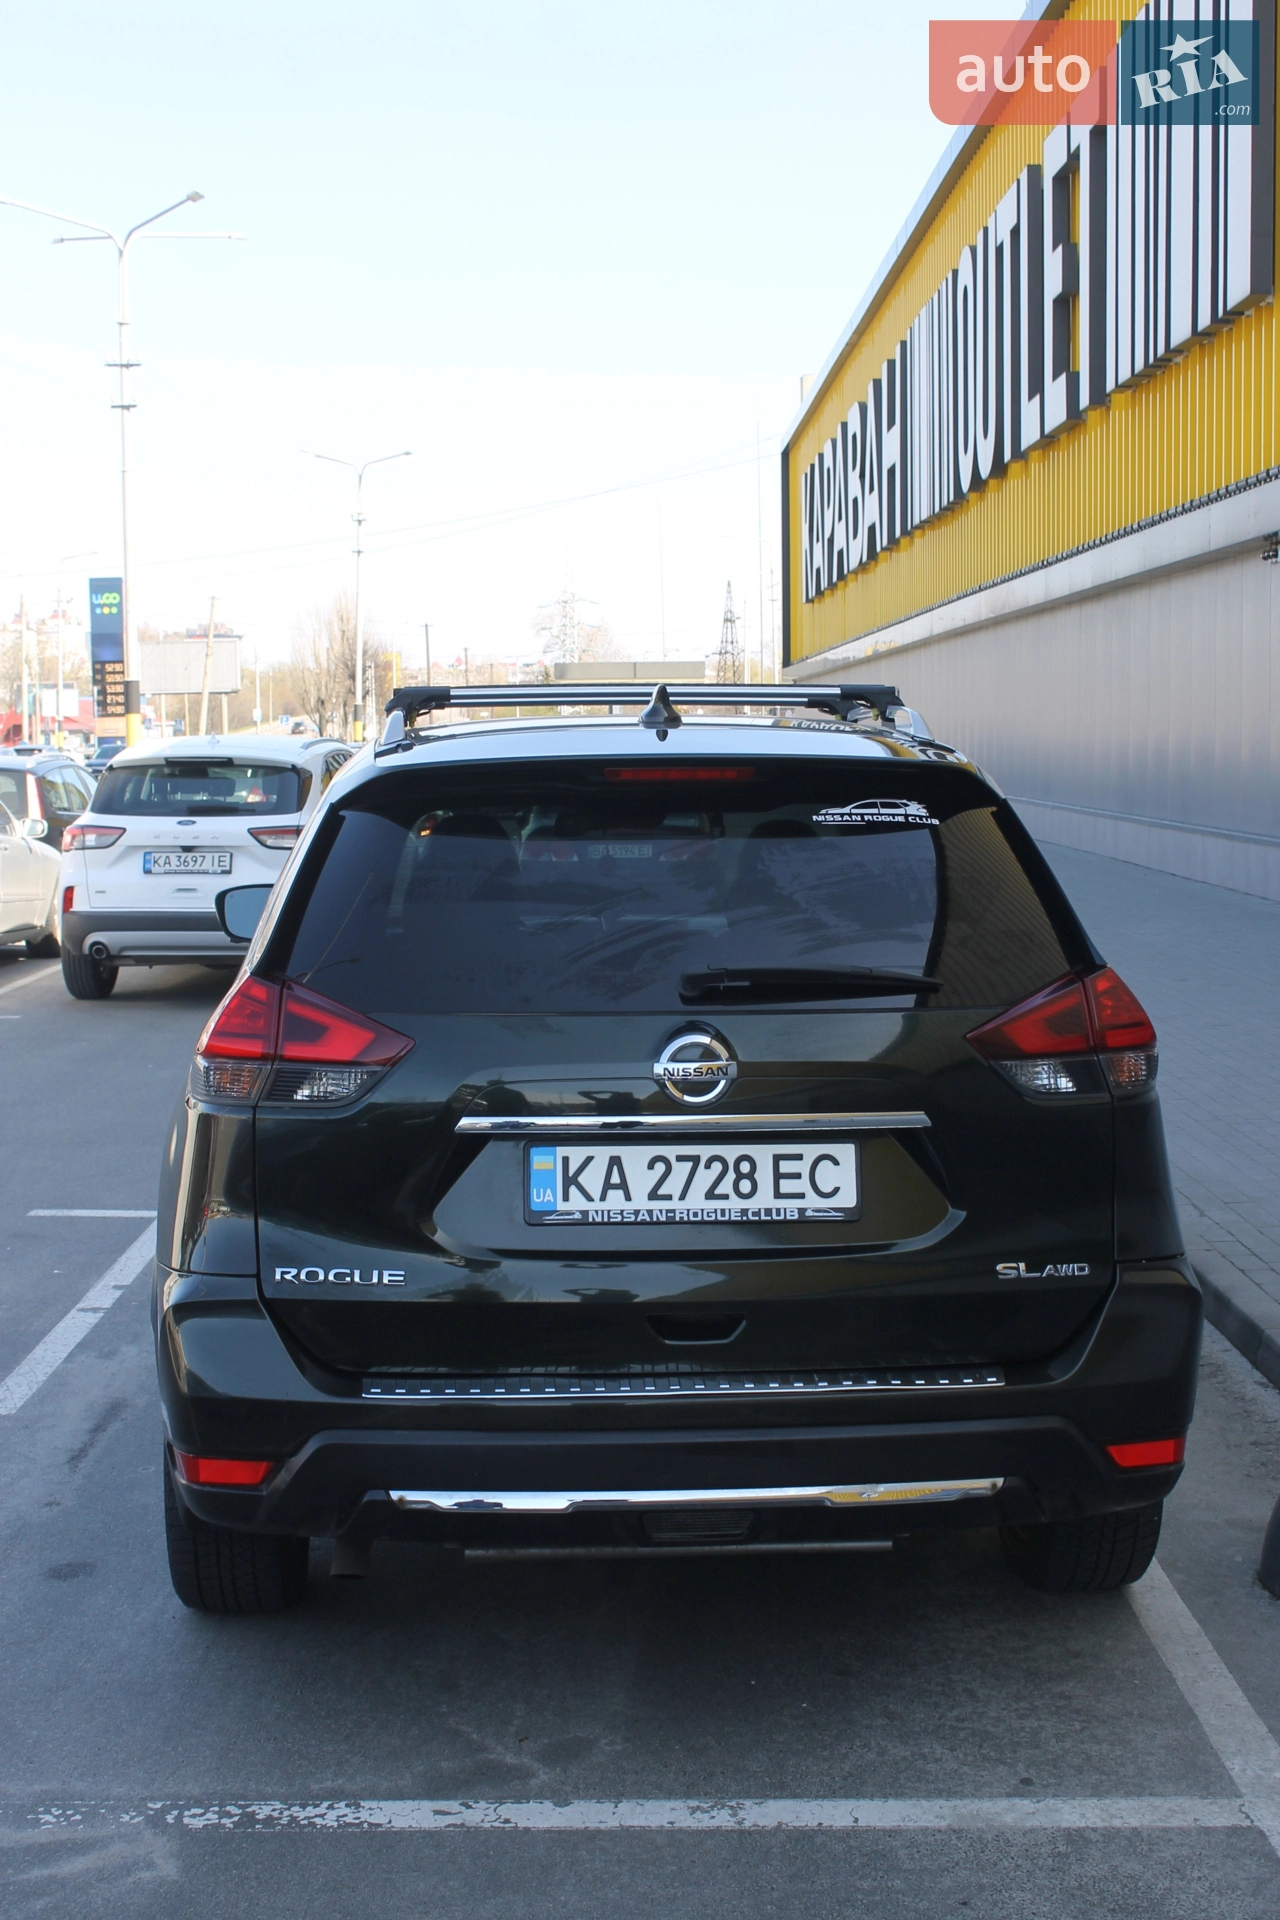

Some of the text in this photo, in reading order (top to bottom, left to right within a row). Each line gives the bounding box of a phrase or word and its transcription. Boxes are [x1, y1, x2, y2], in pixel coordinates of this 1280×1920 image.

[957, 66, 1104, 495] OUTLET
[812, 814, 861, 822] NISSAN
[908, 815, 940, 825] CLUB
[152, 855, 227, 868] KA 3697 IE
[662, 1066, 729, 1078] NISSAN
[561, 1153, 841, 1202] KA 2728 EC
[533, 1188, 554, 1203] UA
[588, 1208, 799, 1222] NISSAN-ROGUE.CLUB
[274, 1267, 406, 1286] ROGUE
